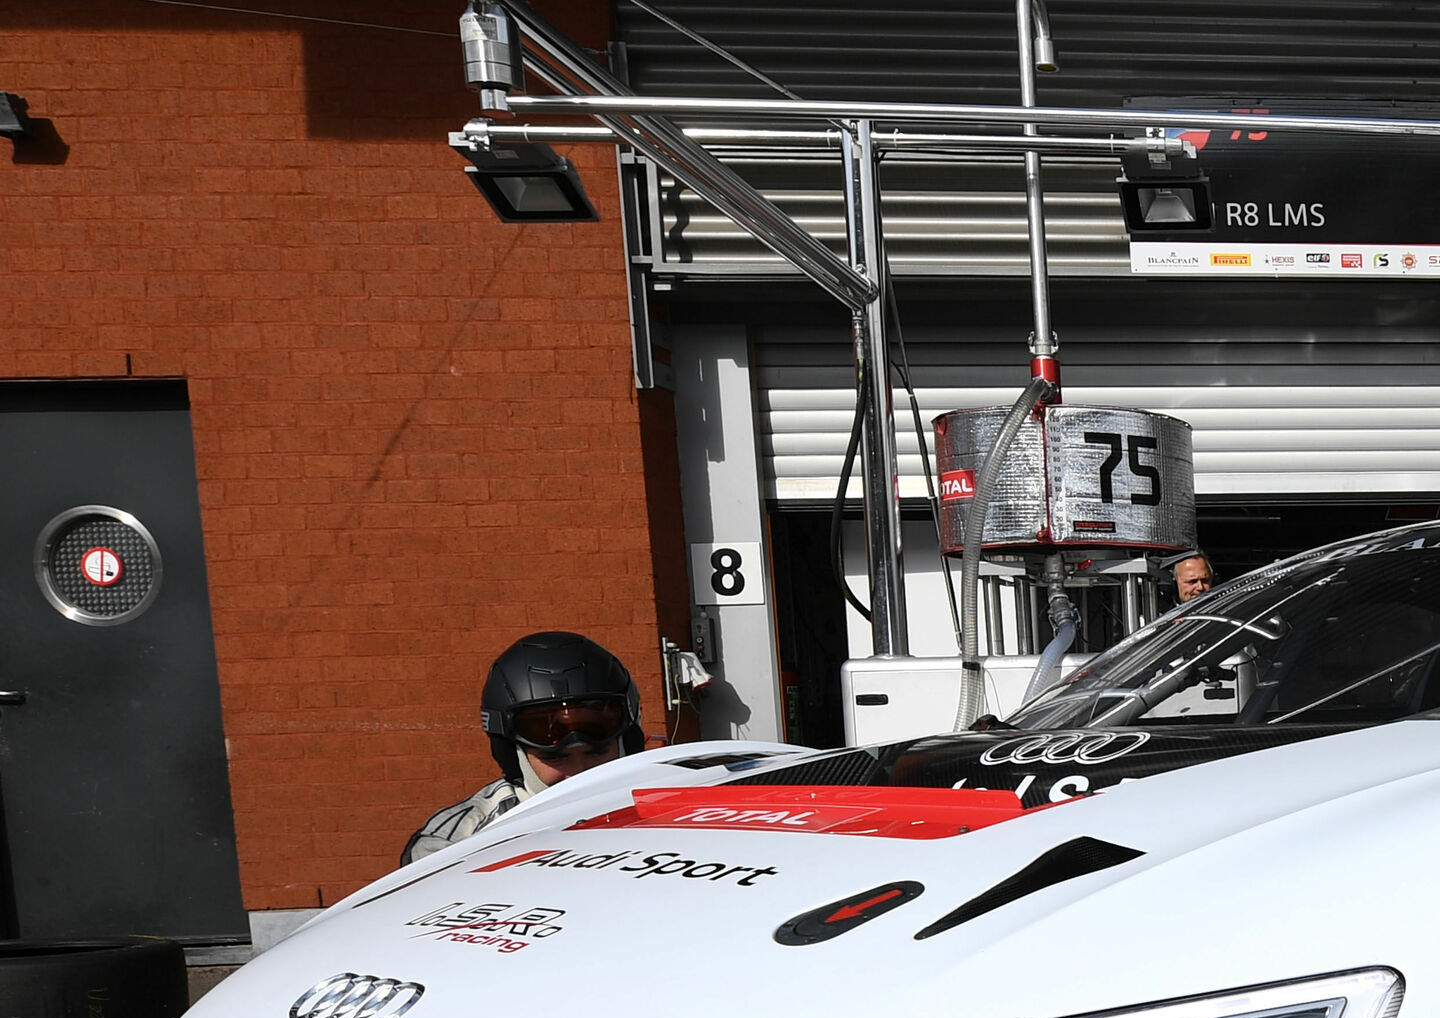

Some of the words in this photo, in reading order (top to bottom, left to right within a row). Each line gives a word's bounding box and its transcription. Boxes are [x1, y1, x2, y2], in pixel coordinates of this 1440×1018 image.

[1226, 202, 1259, 227] R8
[1268, 202, 1326, 227] LMS
[1147, 256, 1200, 265] BLANCPAIN
[1083, 431, 1161, 506] 75
[940, 477, 974, 494] OTAL
[709, 547, 746, 597] 8
[673, 807, 818, 826] TOTAL
[517, 849, 644, 870] Audi
[619, 852, 780, 888] Sport
[434, 931, 531, 954] racing
